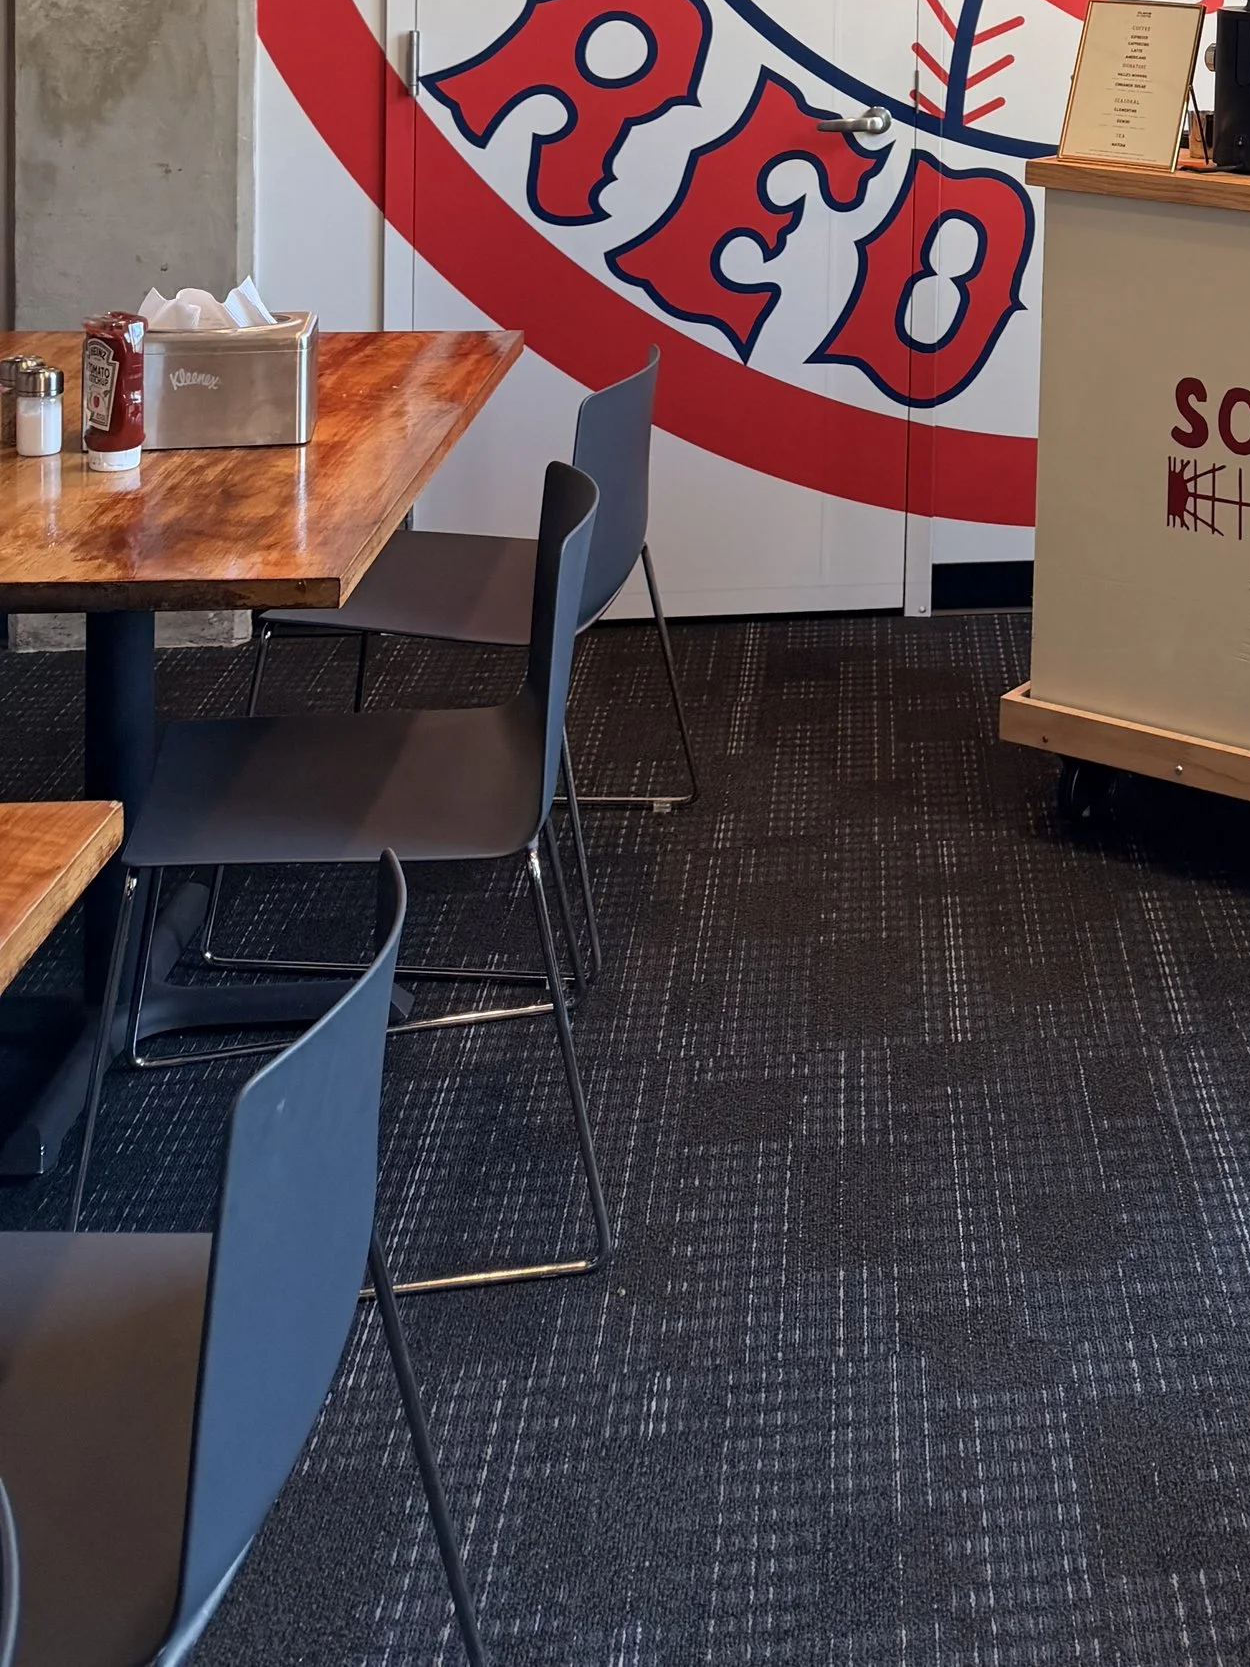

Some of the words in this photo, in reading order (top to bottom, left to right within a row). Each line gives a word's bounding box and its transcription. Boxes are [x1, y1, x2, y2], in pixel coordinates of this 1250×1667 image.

[90, 346, 107, 360] HEINZ
[88, 362, 110, 379] TOMATO
[169, 368, 219, 390] Kleenex
